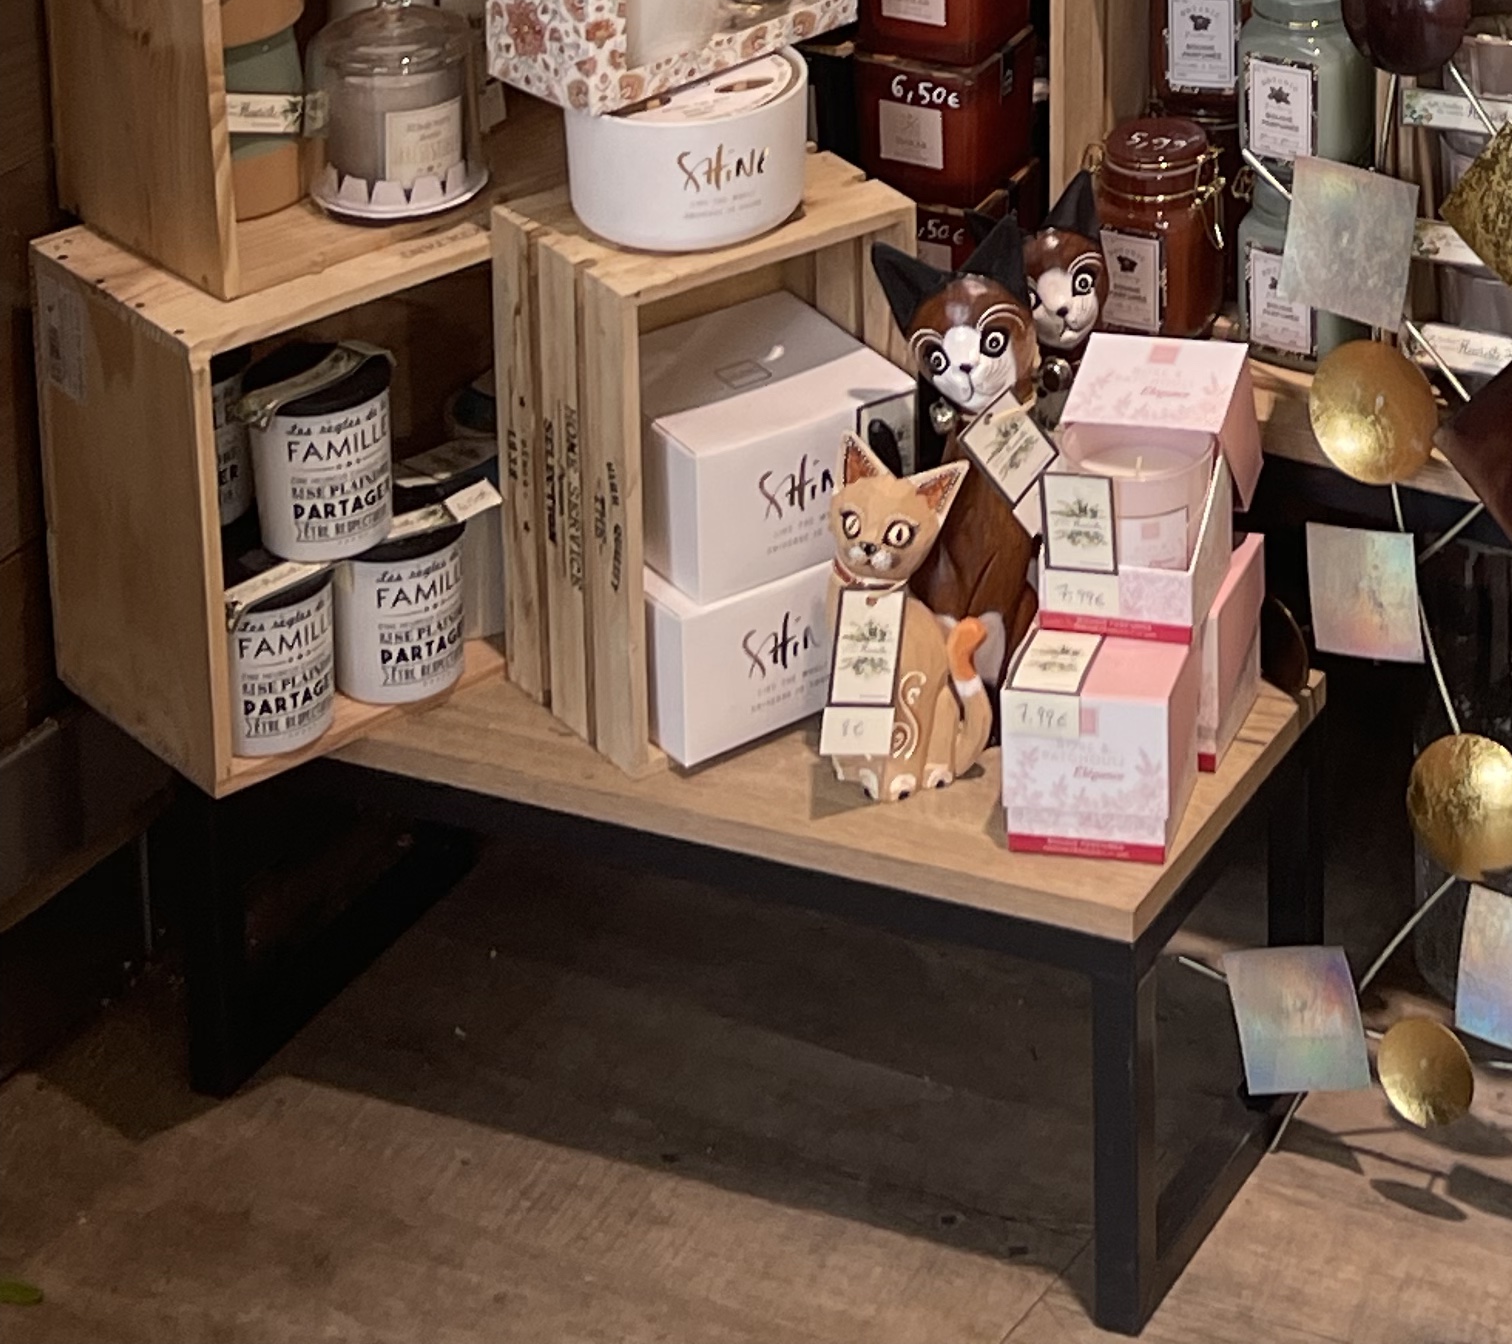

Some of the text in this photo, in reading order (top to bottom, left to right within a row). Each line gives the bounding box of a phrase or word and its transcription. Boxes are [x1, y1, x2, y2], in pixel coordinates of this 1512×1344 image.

[890, 73, 961, 109] 6,50€
[917, 218, 964, 245] ,50€
[292, 476, 389, 521] PARTAGE
[237, 613, 334, 660] FAMILL
